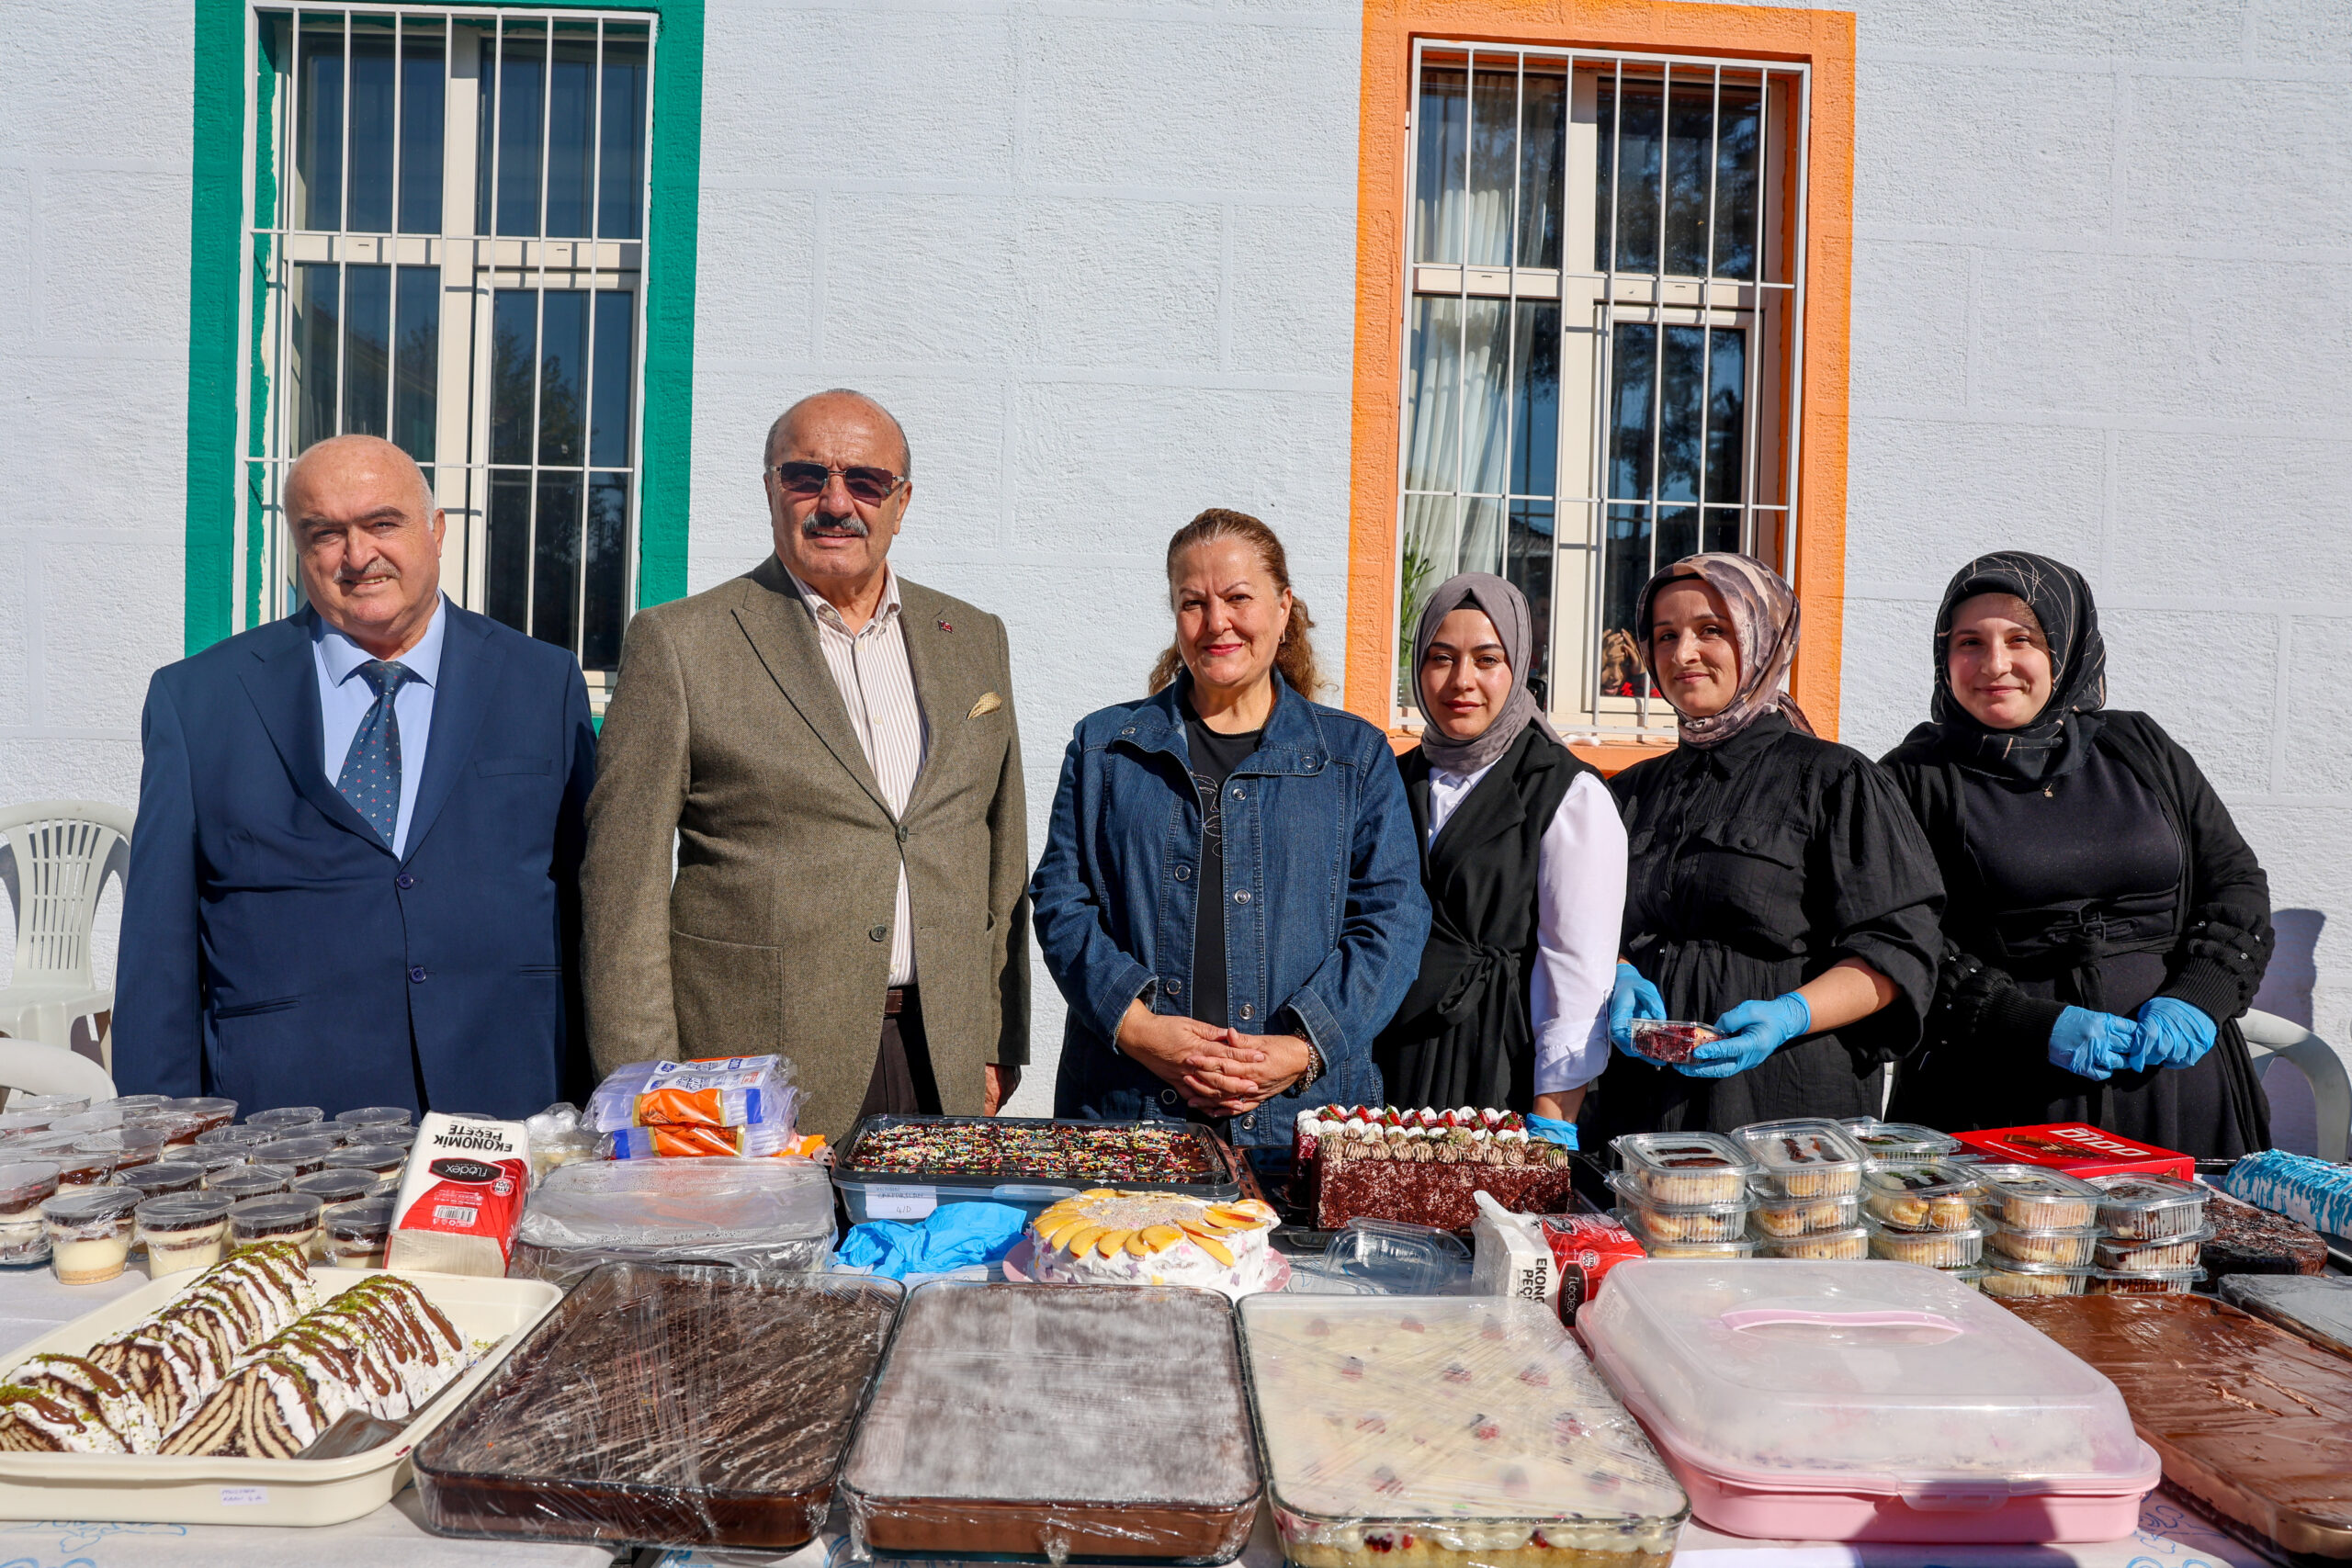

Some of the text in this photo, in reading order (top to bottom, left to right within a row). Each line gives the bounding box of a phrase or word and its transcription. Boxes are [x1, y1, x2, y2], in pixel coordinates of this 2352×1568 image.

[449, 1123, 503, 1142] PEÇETE
[434, 1134, 513, 1153] EKONOMİK
[1521, 1269, 1533, 1299] PEÇ
